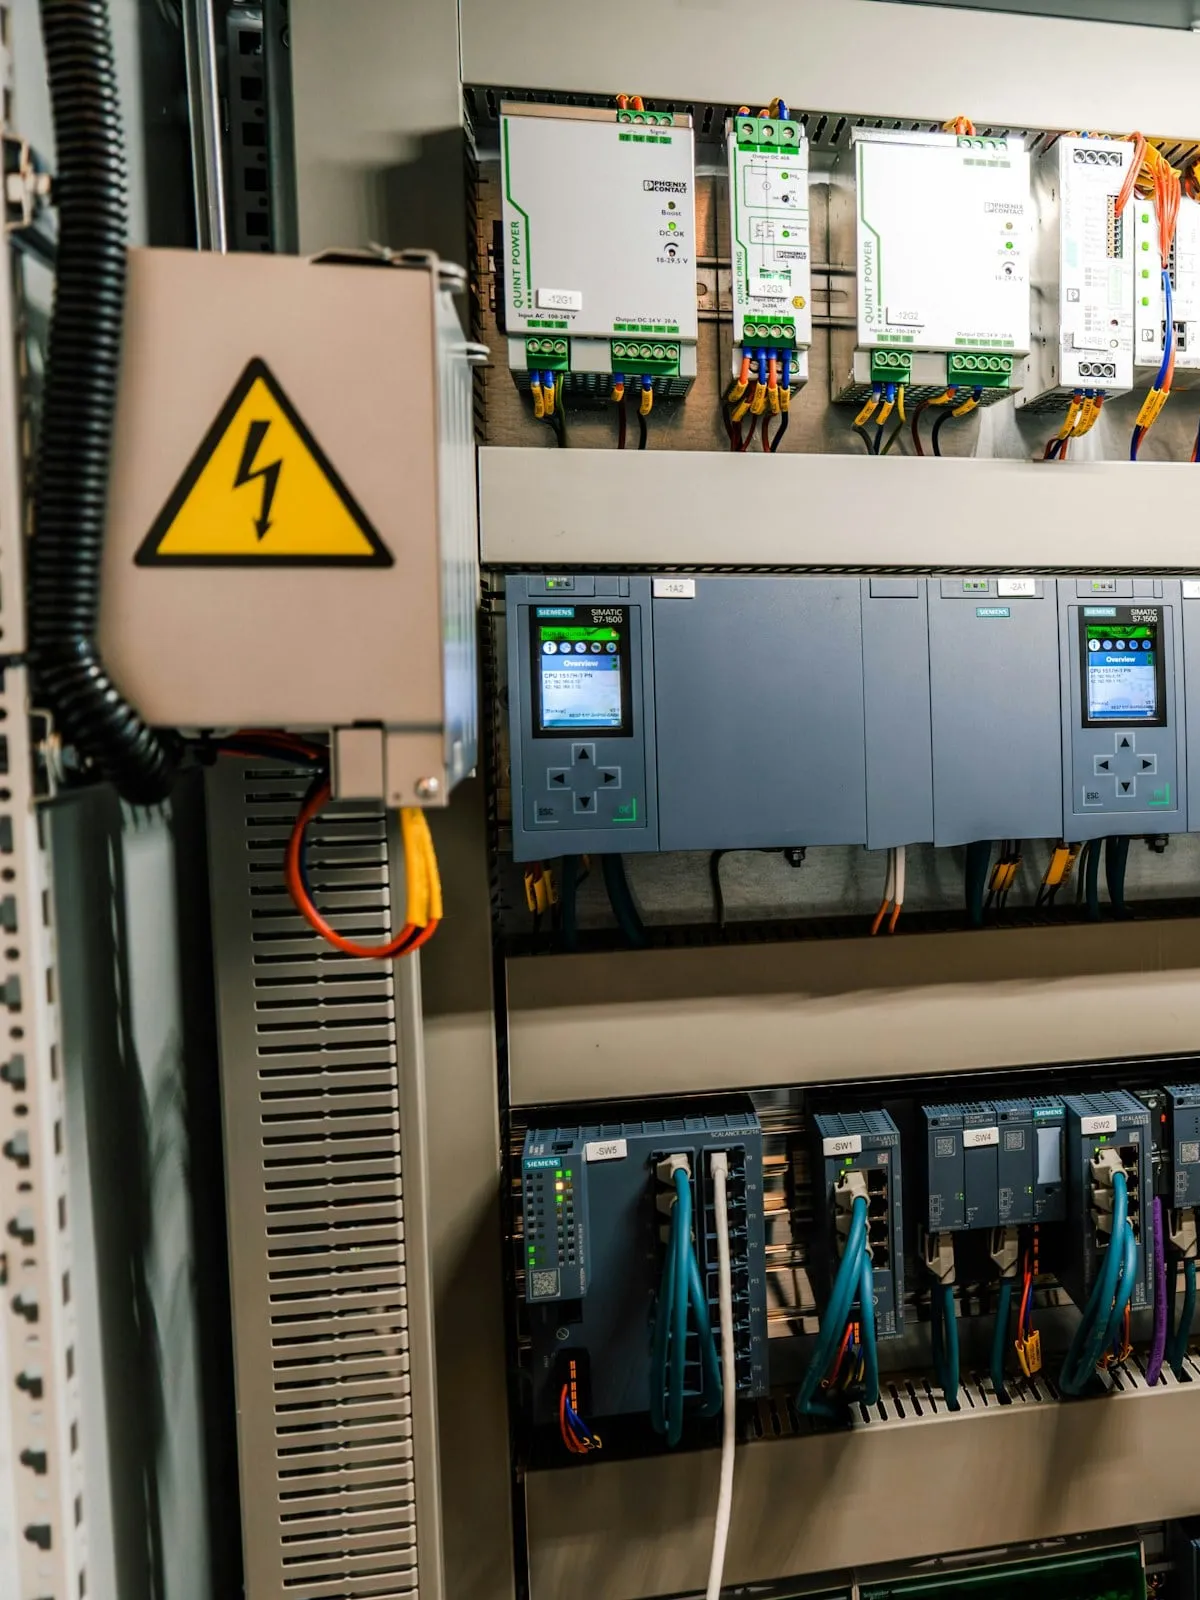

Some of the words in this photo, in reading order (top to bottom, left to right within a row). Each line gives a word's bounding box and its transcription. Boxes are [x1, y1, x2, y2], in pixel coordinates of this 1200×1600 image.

[511, 221, 521, 266] POWER
[863, 241, 872, 282] POWER
[513, 269, 524, 309] QUINT
[548, 295, 573, 305] -12G1
[864, 286, 874, 324] QUINT
[616, 316, 637, 324] Output
[896, 311, 919, 321] -12G2
[665, 584, 685, 593] -1A2
[592, 616, 623, 624] S7-1500
[563, 660, 599, 668] Overview
[1106, 655, 1136, 663] Overview
[1087, 792, 1099, 800] ESC
[1036, 1109, 1062, 1117] SIEMENS
[1091, 1120, 1110, 1130] -SW2
[972, 1133, 992, 1143] -SW4
[596, 1145, 618, 1156] -SW5
[832, 1141, 853, 1151] -SW1
[527, 1160, 558, 1168] SIEMENS
